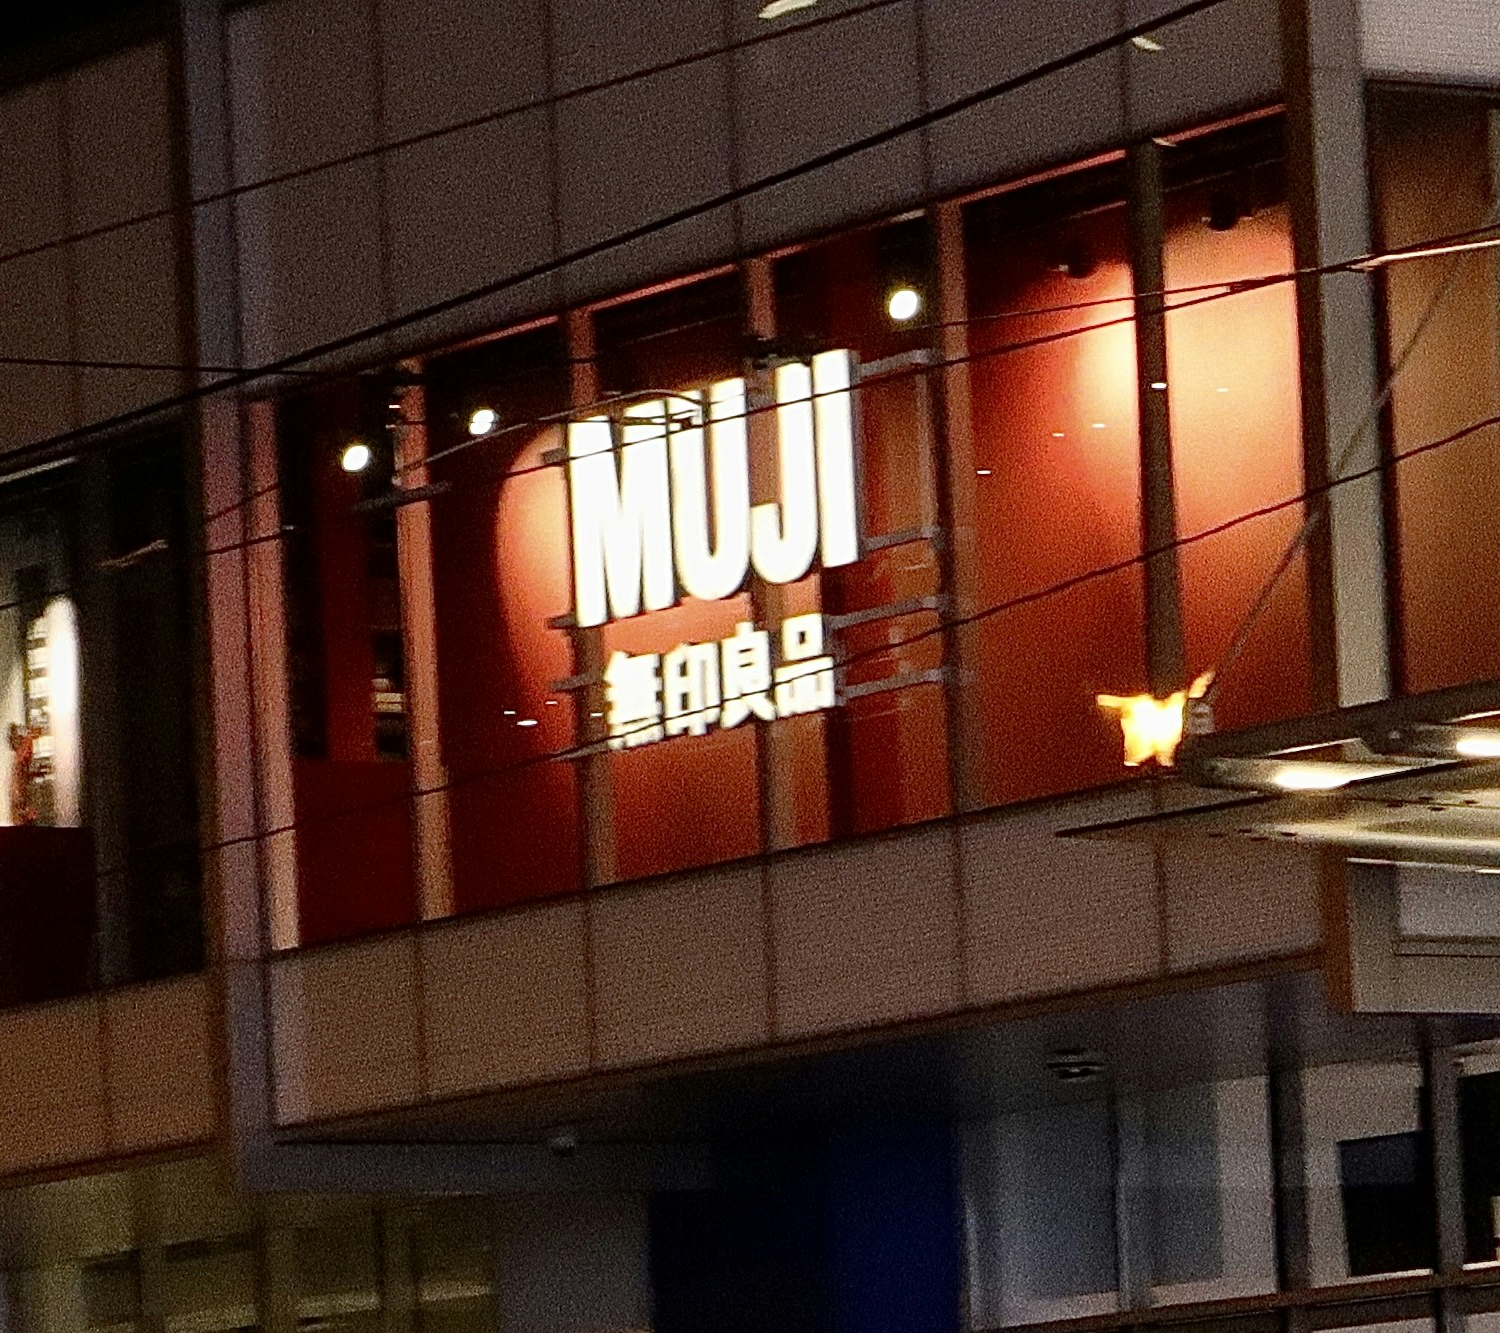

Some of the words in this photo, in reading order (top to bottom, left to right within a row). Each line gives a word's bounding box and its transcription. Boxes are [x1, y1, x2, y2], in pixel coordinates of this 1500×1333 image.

[567, 348, 859, 629] MUJI
[604, 612, 836, 751] 無印良品
